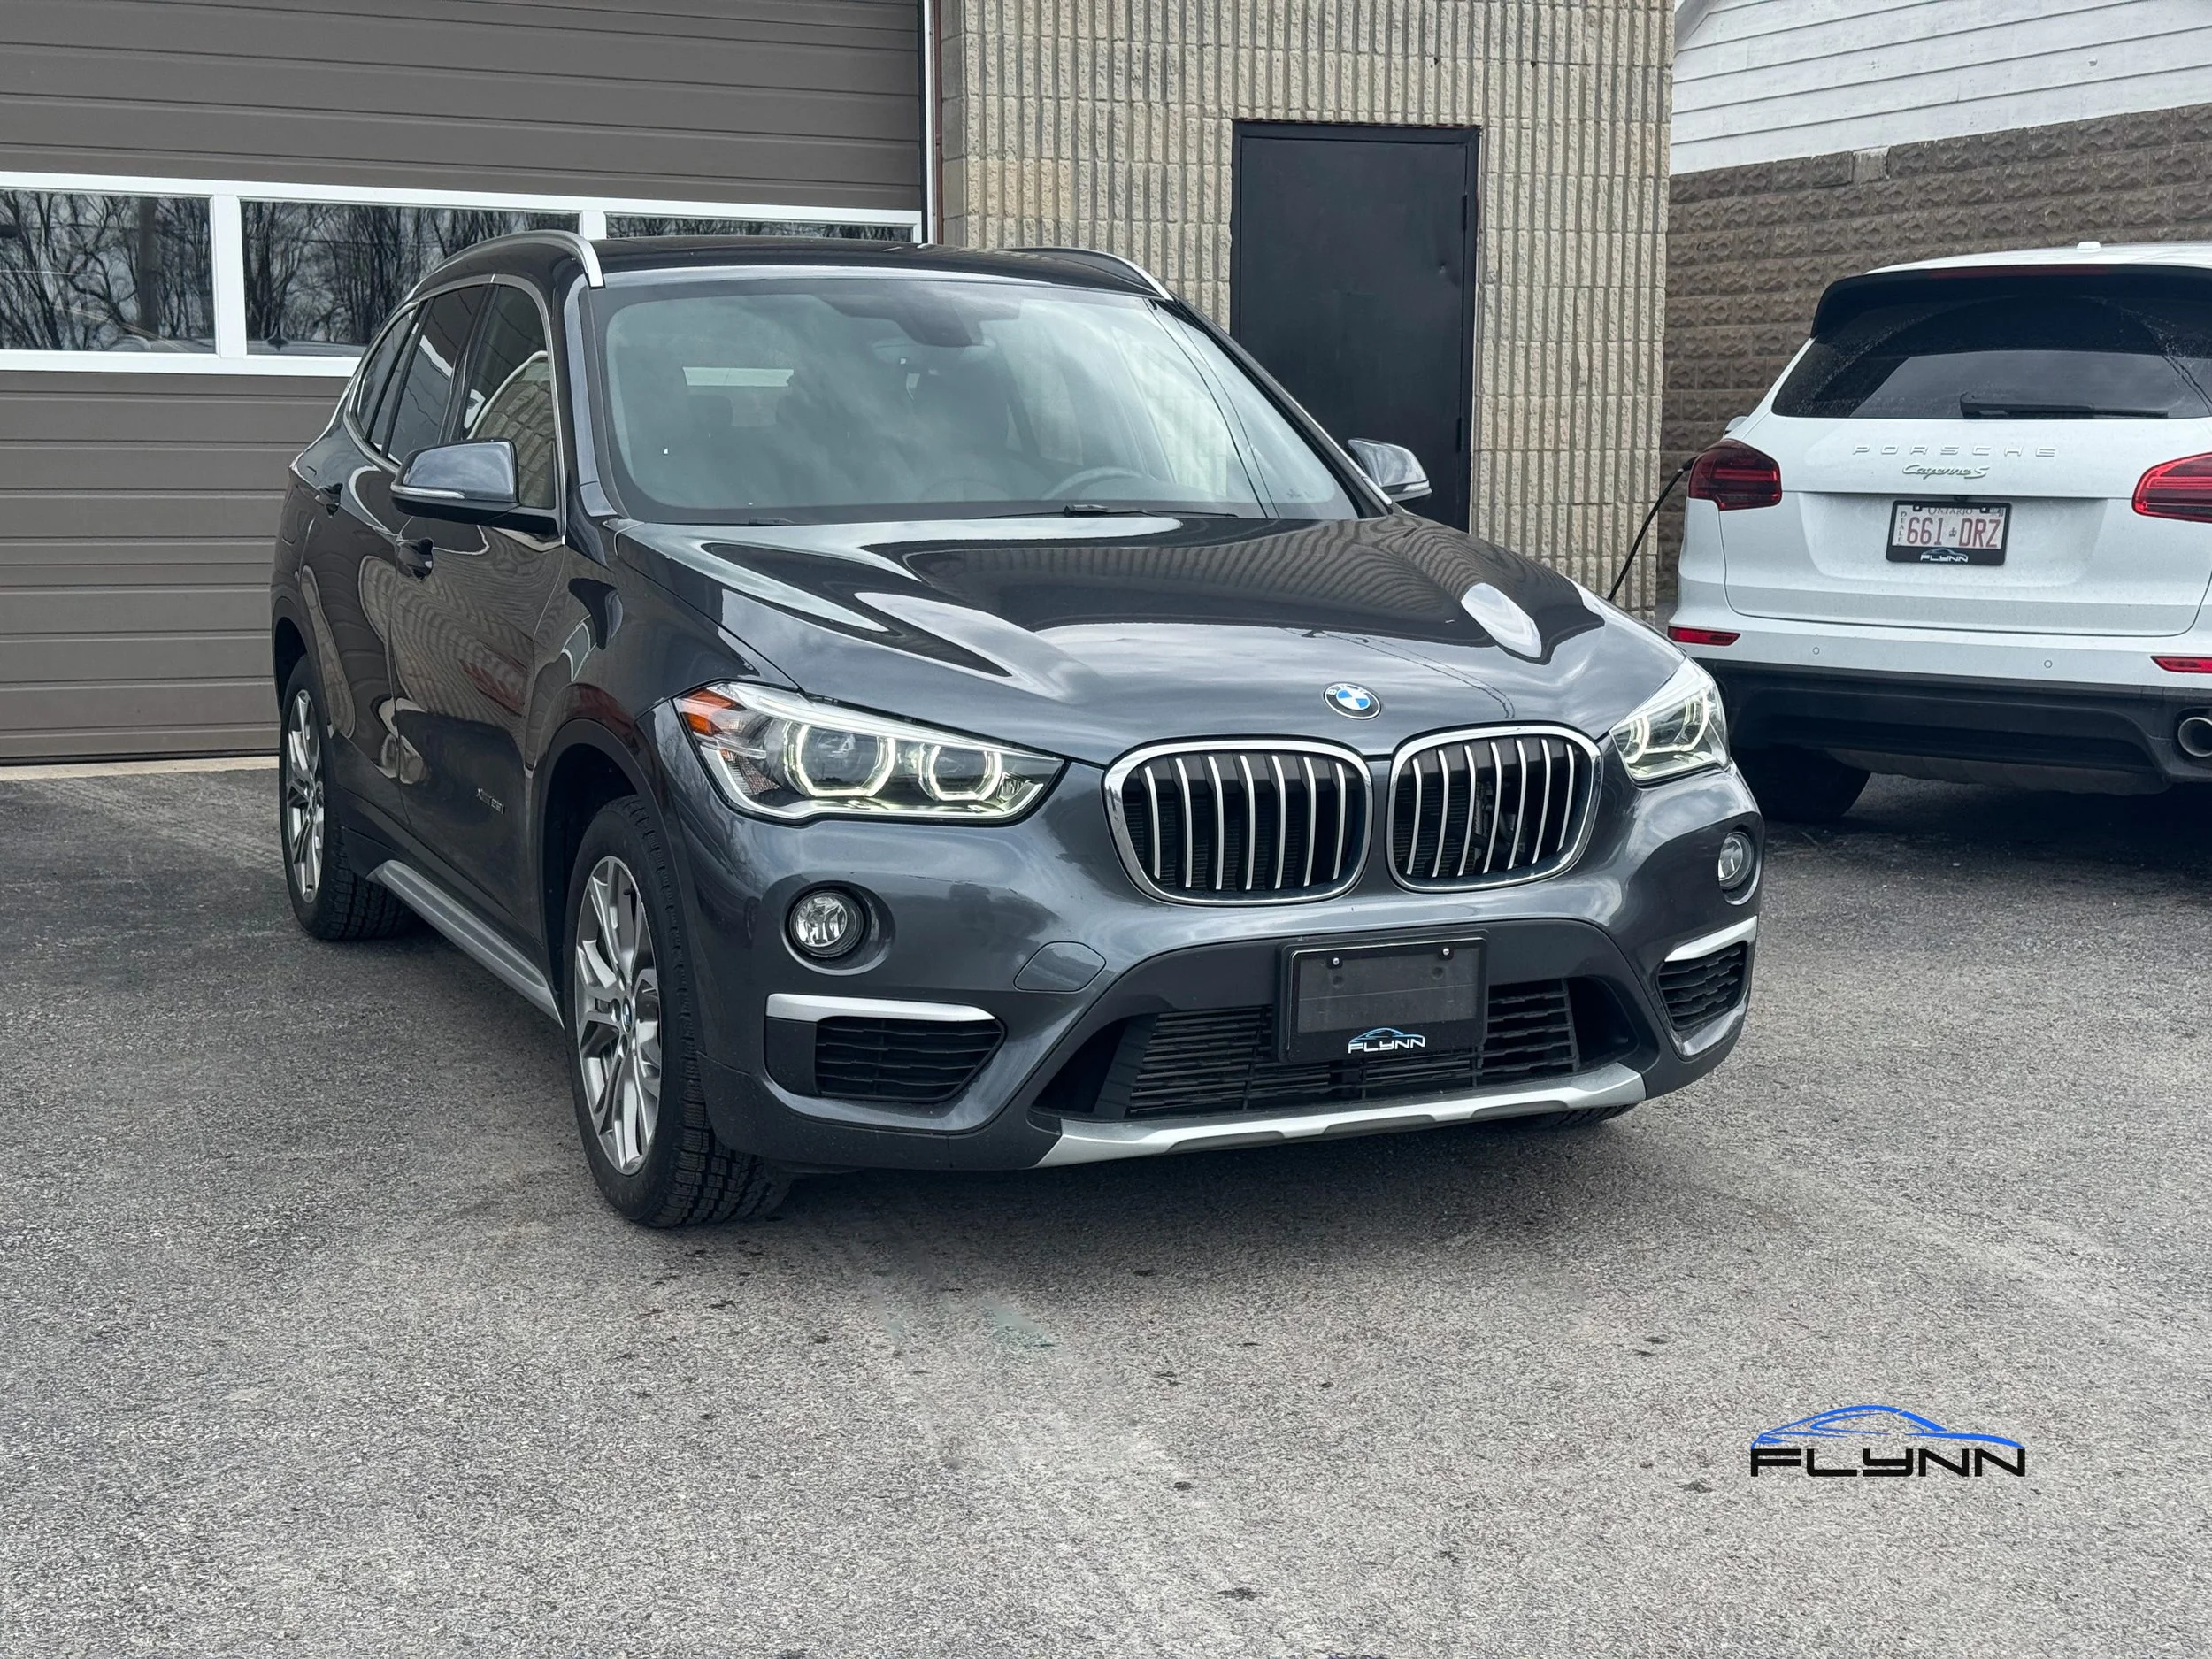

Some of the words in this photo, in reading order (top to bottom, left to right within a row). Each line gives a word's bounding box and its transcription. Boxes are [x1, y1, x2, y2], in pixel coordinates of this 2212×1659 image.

[1852, 445, 2057, 457] PORSCHE
[1902, 464, 1971, 480] Cayenne
[1963, 466, 1990, 479] S
[1897, 511, 1908, 546] DEALE
[1906, 517, 1944, 546] 661
[1958, 518, 2001, 548] DRZ
[1920, 554, 1969, 563] FLYNN
[1348, 1038, 1425, 1054] FLYNN
